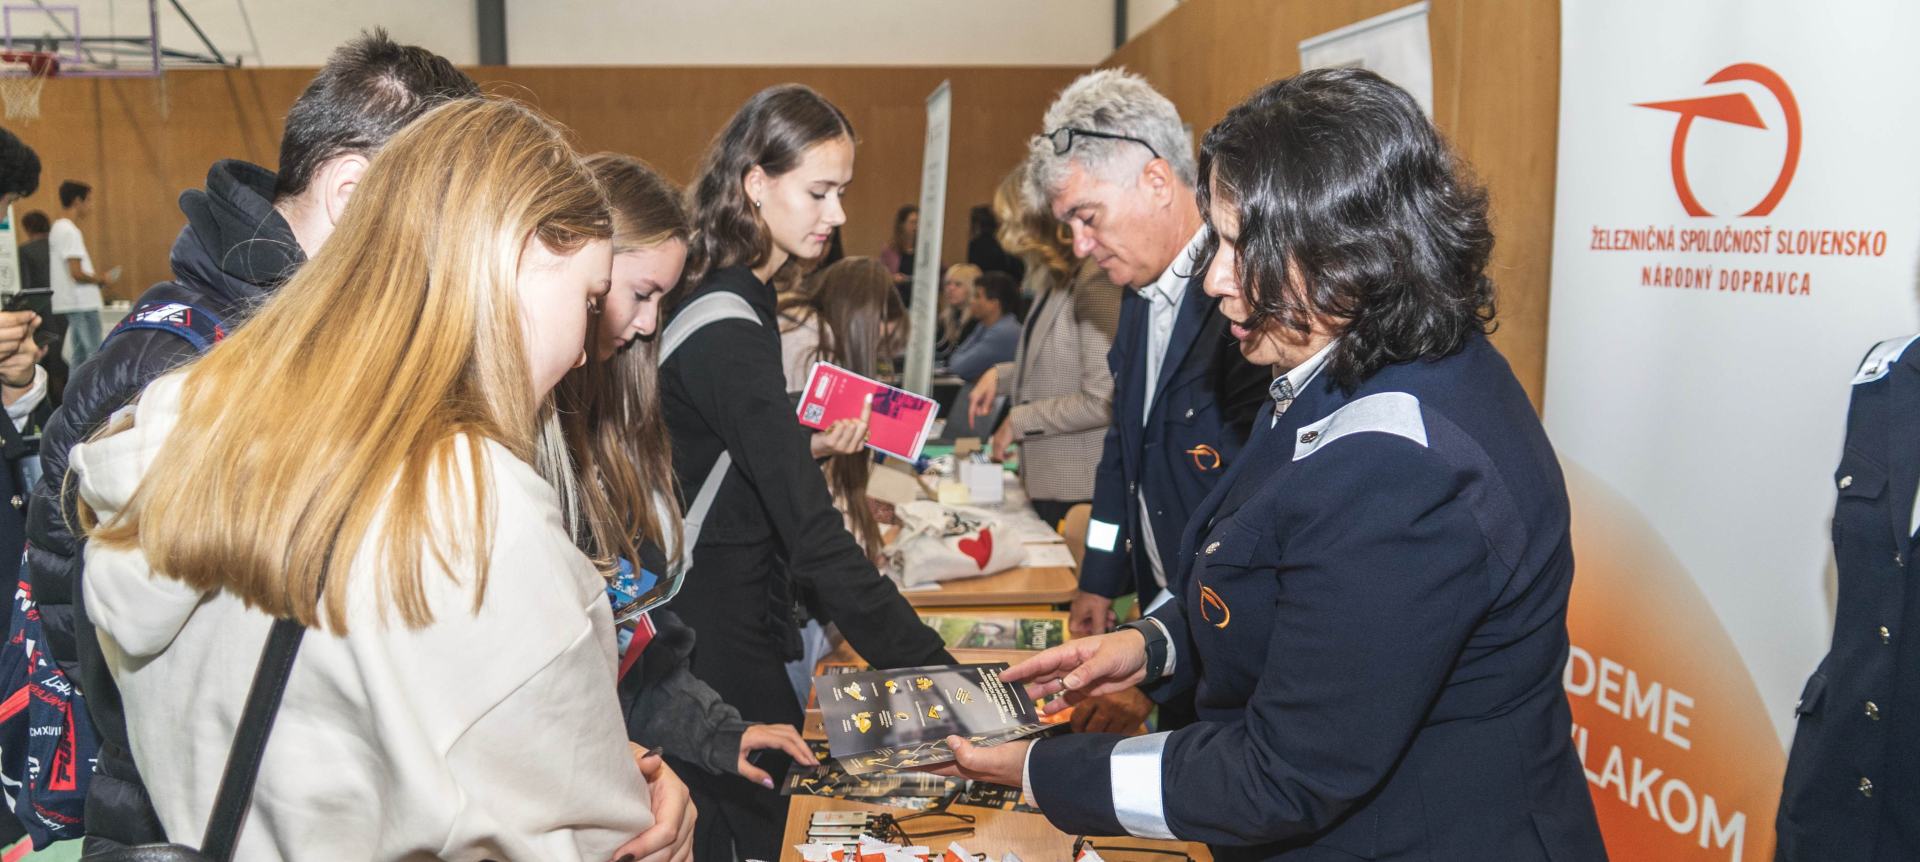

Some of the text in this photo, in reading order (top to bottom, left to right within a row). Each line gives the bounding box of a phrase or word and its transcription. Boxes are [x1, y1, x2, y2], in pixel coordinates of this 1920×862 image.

[1590, 225, 1887, 257] ŽELEZNIČNÁ SPOLOČNOSŤ SLOVENSKO
[1641, 263, 1811, 295] NÁRODNÝ DOPRAVCA
[1563, 645, 1695, 751] DEME
[1571, 723, 1747, 862] LAKOM
